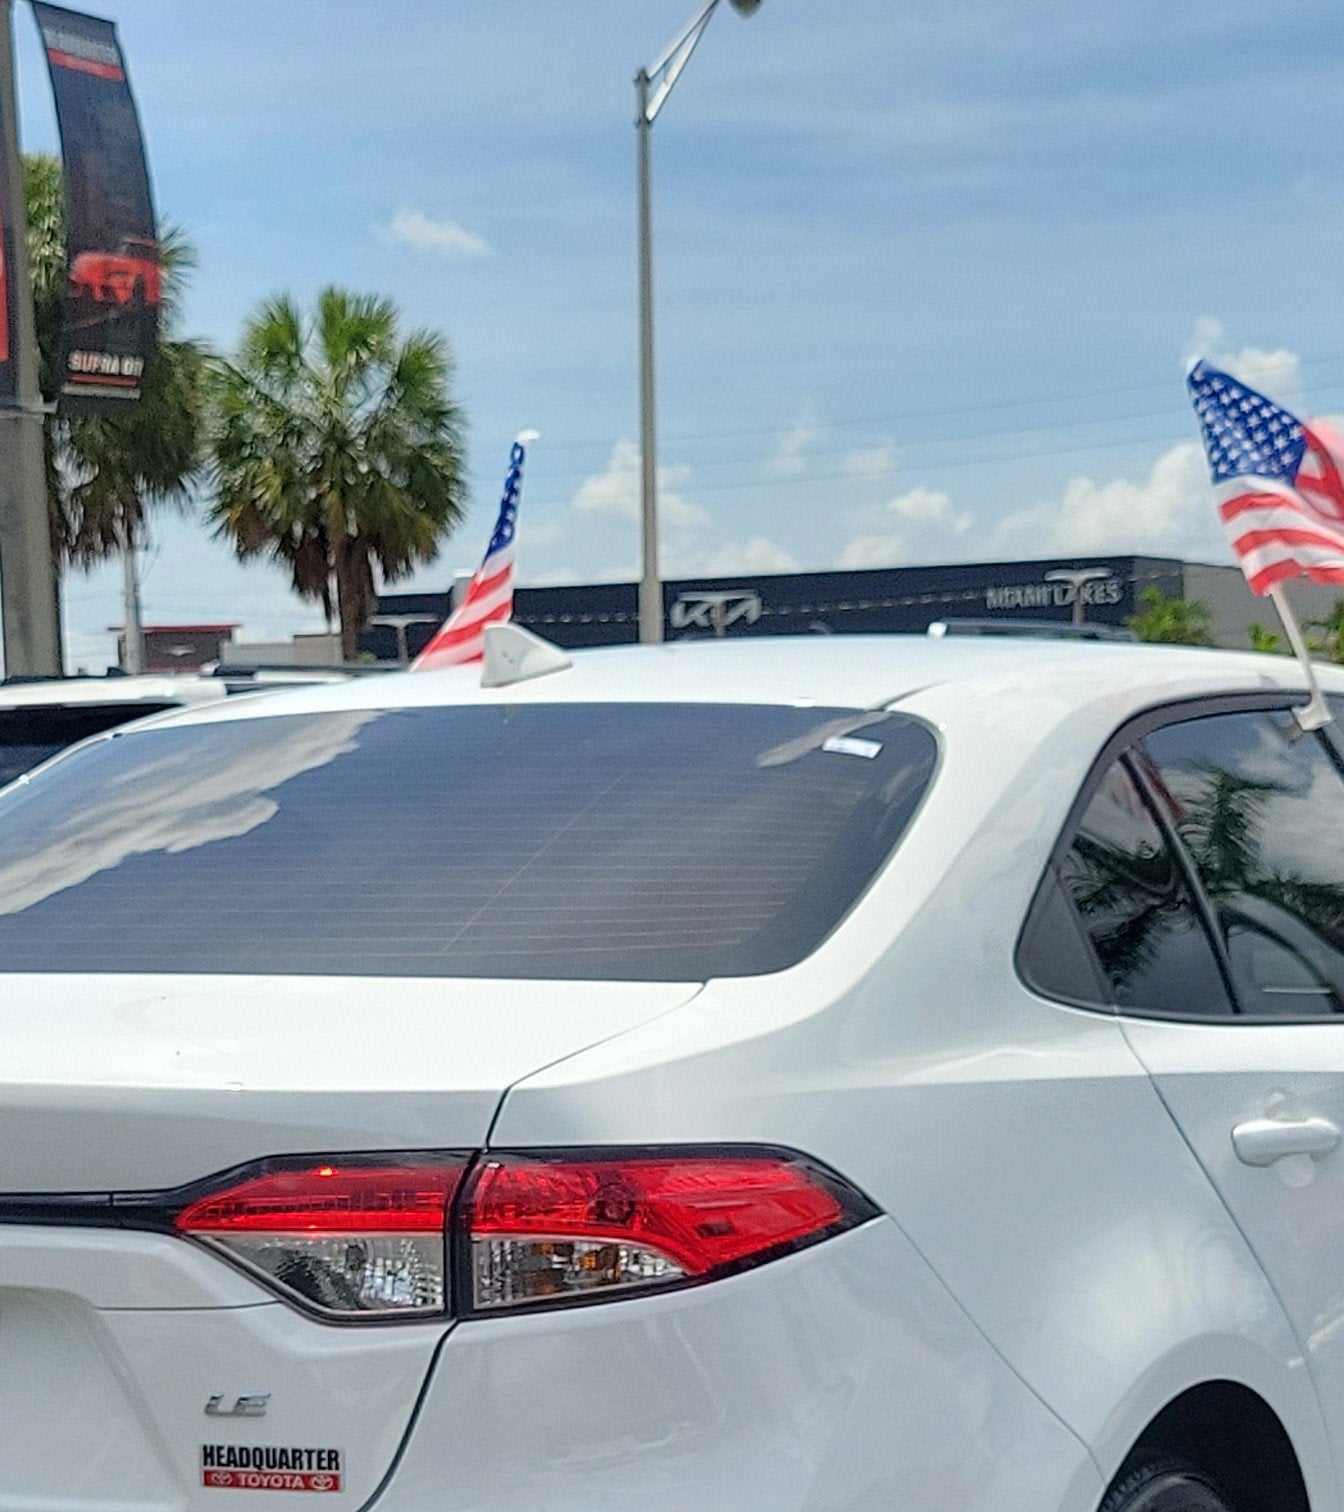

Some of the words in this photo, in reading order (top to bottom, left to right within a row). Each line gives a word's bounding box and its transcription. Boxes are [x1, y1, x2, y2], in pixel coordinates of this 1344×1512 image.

[203, 1392, 272, 1418] LE
[202, 1444, 340, 1471] HEADQUARTER
[238, 1473, 306, 1489] TOYOTA
